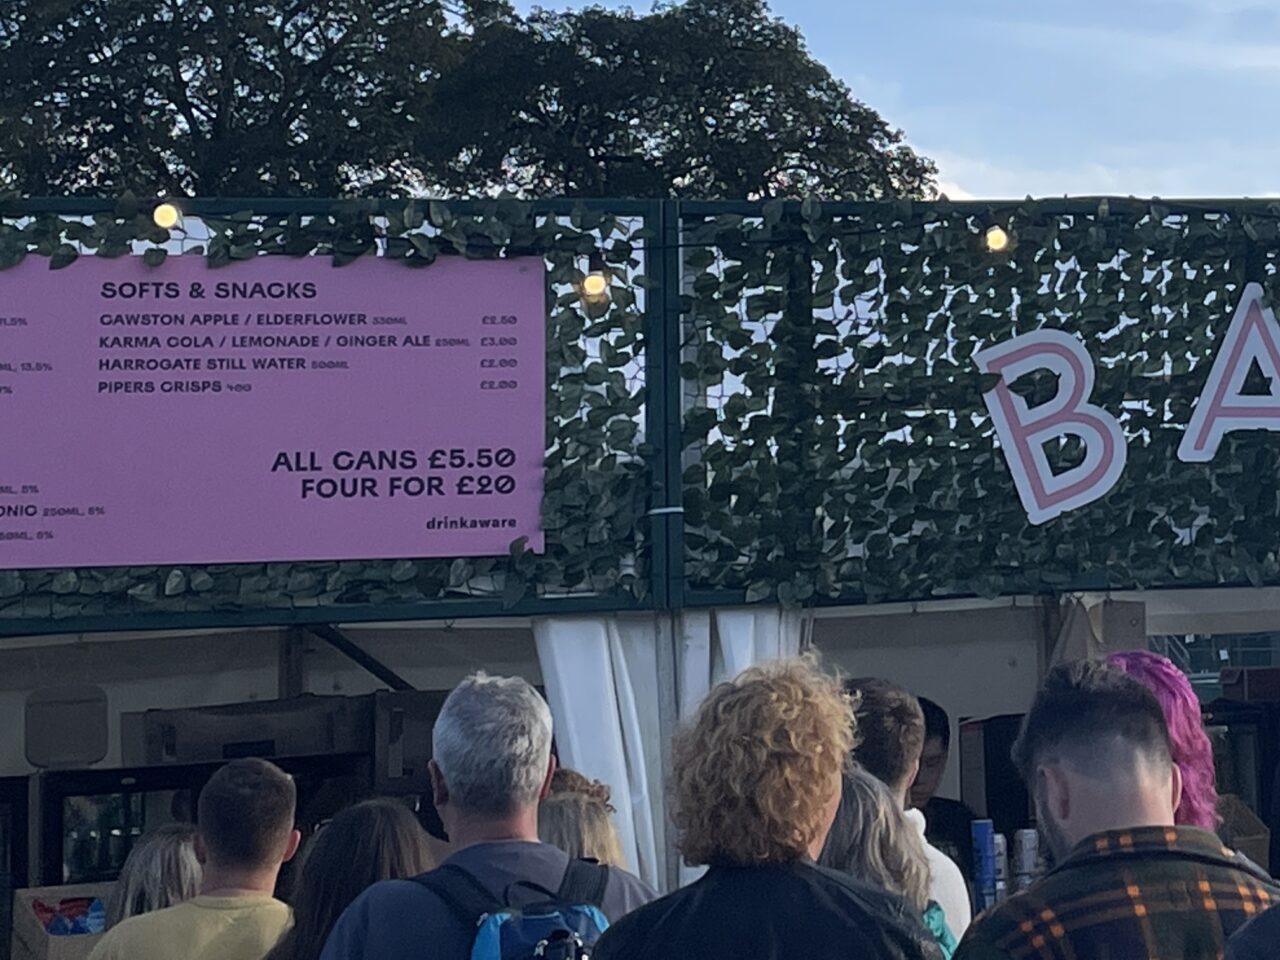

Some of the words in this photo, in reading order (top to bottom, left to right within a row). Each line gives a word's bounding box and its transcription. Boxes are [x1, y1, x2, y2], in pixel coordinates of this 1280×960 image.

[101, 282, 180, 298] SOFTS
[189, 282, 205, 299] &
[214, 282, 316, 299] SNACKS
[100, 314, 184, 325] CAWSTON
[190, 314, 239, 325] APPLE
[244, 314, 251, 325] /
[257, 314, 367, 325] ELDERFLOWER
[482, 316, 517, 324] £2.50
[99, 336, 161, 348] KARMA
[167, 336, 214, 348] COLA
[219, 336, 226, 348] /
[232, 336, 319, 347] LEMONADE
[324, 336, 331, 347] /
[337, 336, 397, 347] GINGER
[402, 335, 430, 346] ALE
[481, 337, 517, 346] £3.00
[99, 359, 201, 370] HARROGATE
[207, 358, 246, 370] STILL
[252, 358, 306, 369] WATER
[480, 359, 517, 368] £2.00
[98, 381, 155, 393] PIPERS
[160, 381, 222, 392] CRISPS
[480, 380, 517, 389] £2.00
[271, 452, 322, 472] ALL
[333, 450, 417, 470] CANS
[428, 448, 516, 469] £5.50
[302, 478, 379, 498] FOUR
[389, 476, 445, 496] FOR
[456, 475, 515, 495] £20
[427, 516, 516, 529] drinkaware
